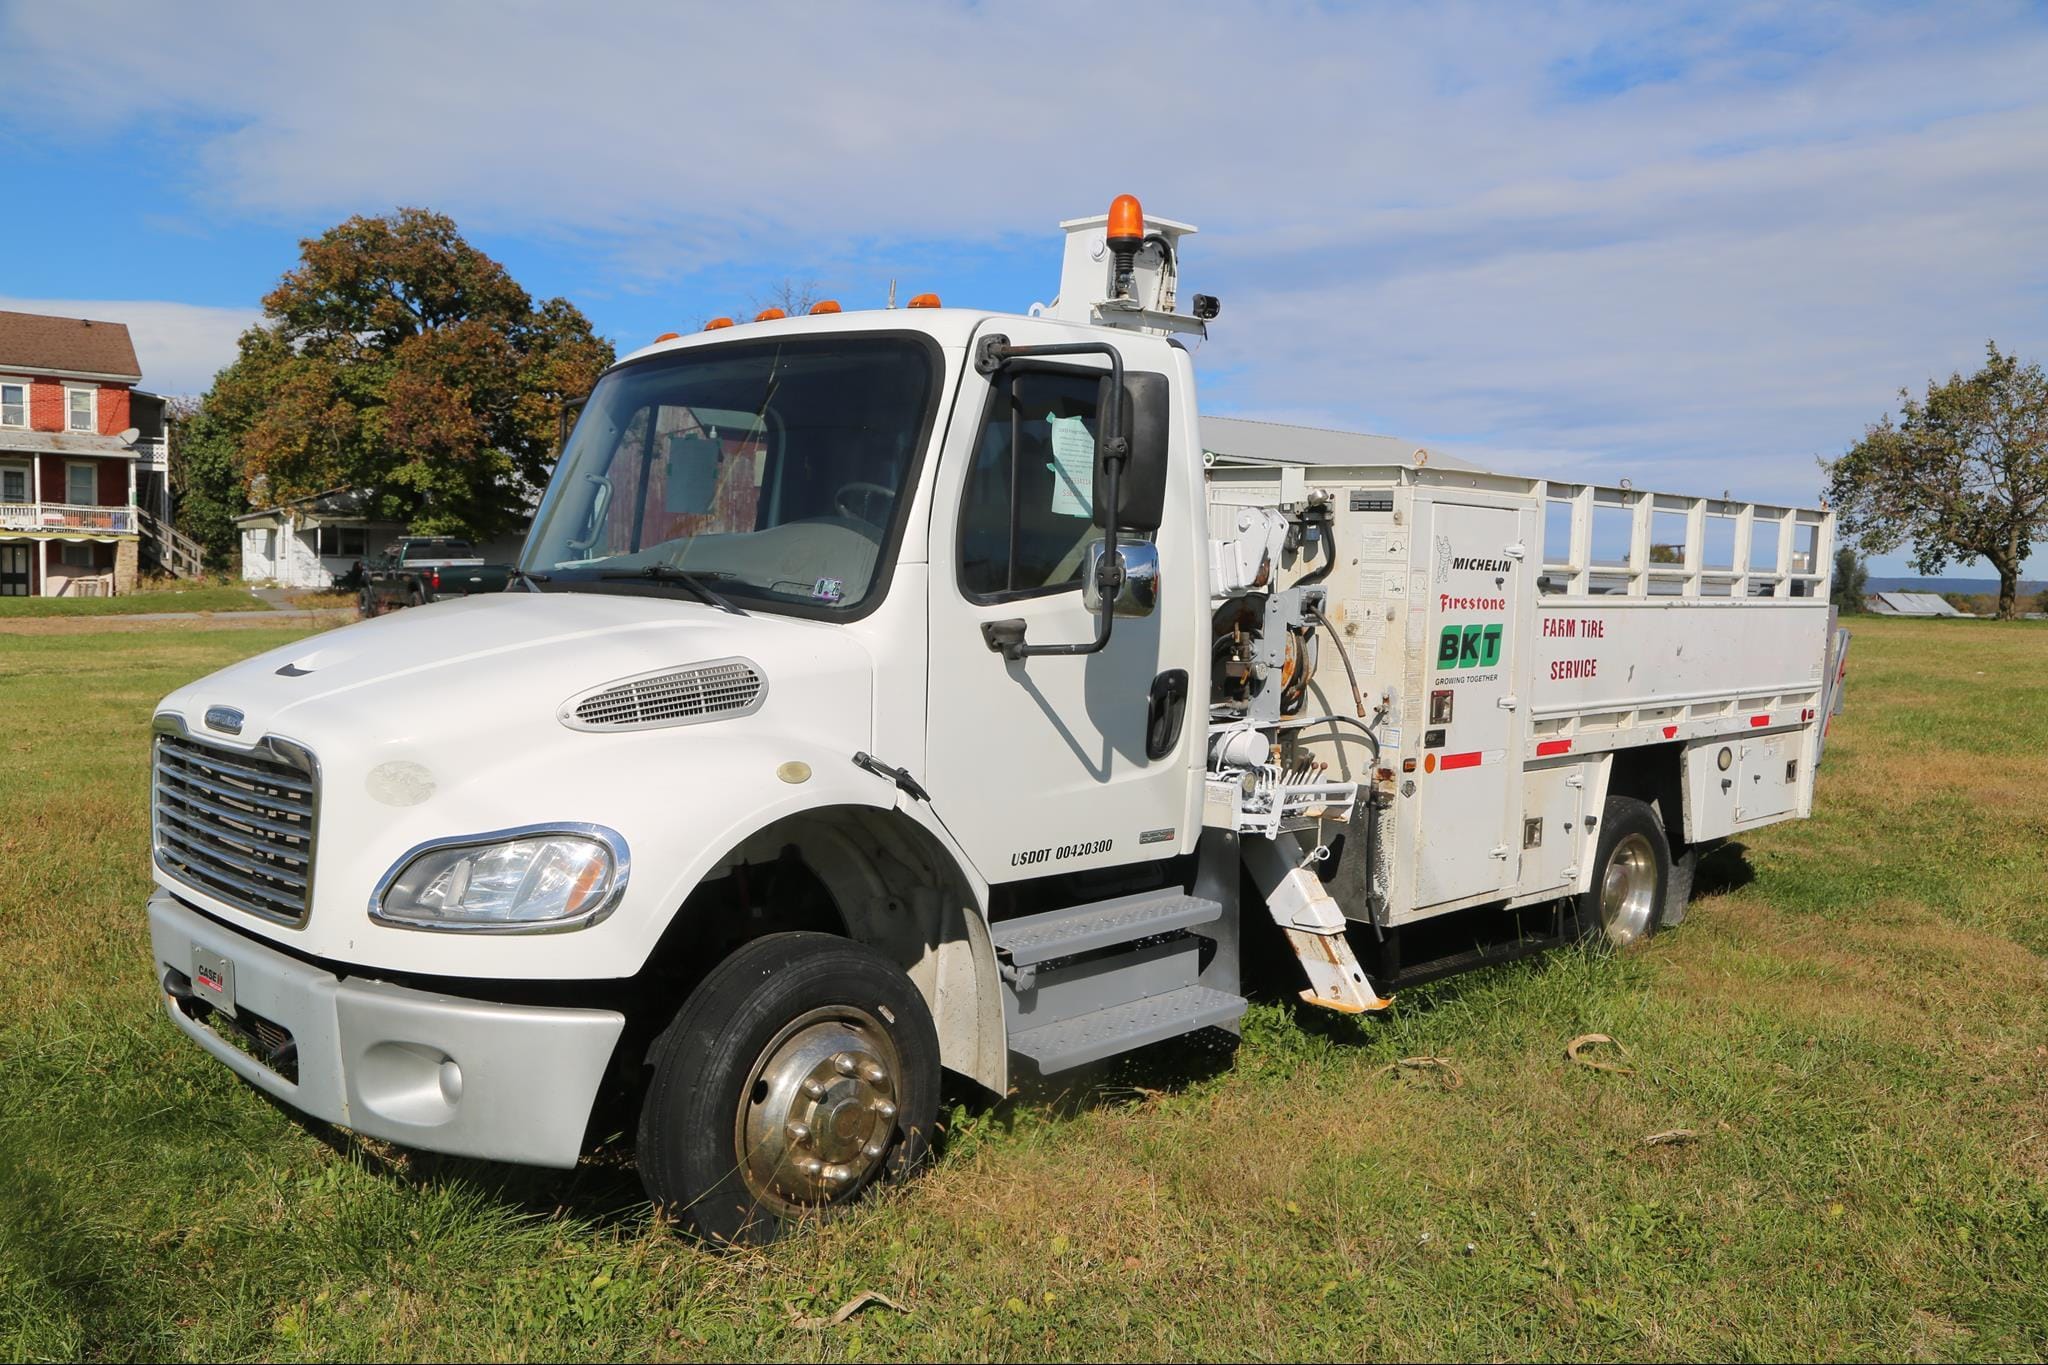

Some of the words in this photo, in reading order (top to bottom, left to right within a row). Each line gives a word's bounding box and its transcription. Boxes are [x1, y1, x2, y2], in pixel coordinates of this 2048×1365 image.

[1452, 557, 1511, 572] MICHELIN
[1440, 594, 1505, 612] Firestone
[1543, 618, 1576, 637] FARM
[1439, 632, 1501, 661] BKT
[1550, 659, 1597, 680] SERVICE
[1435, 676, 1465, 686] GROWING
[1466, 674, 1498, 683] TOGETHER
[1011, 849, 1052, 866] USDOT
[1056, 839, 1112, 859] 00420300
[198, 964, 217, 982] CASE
